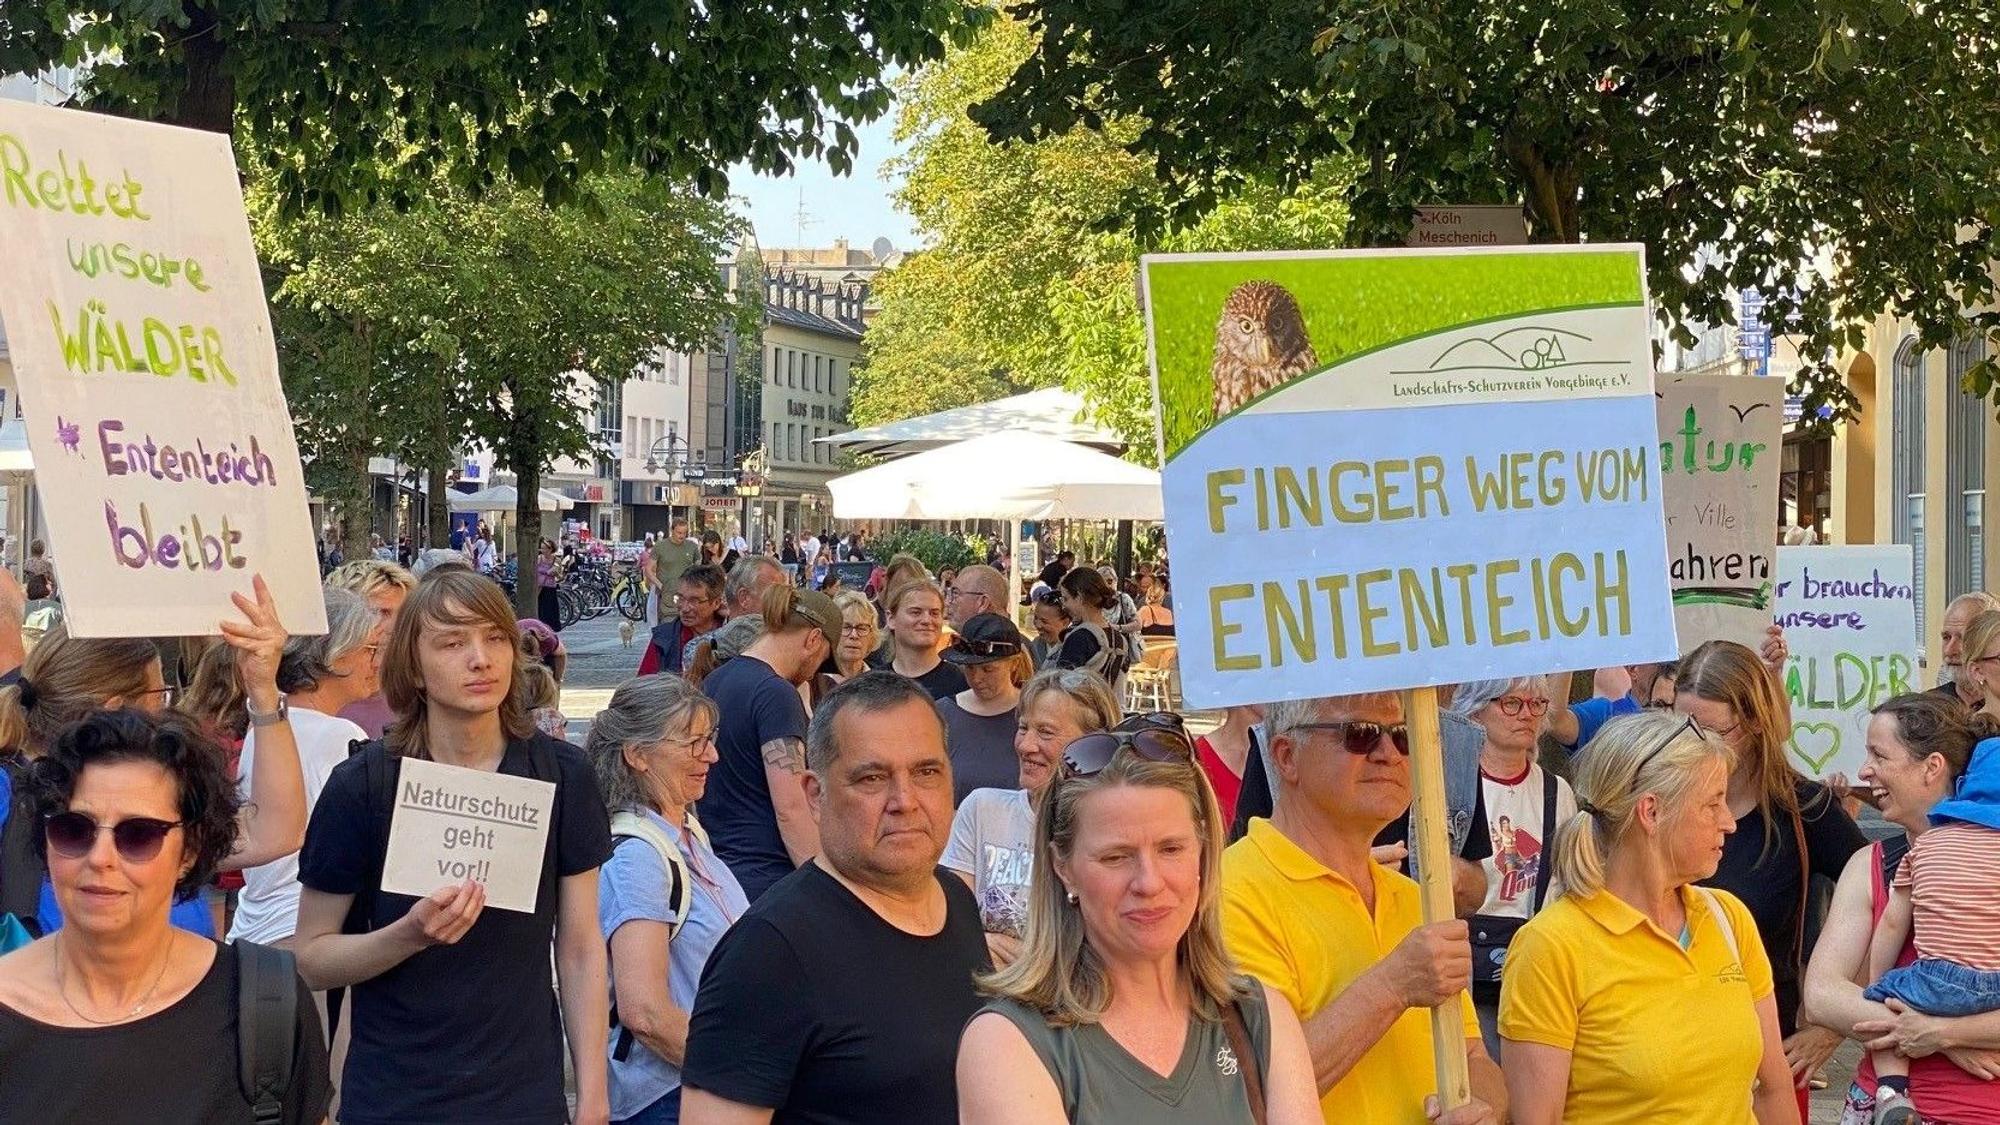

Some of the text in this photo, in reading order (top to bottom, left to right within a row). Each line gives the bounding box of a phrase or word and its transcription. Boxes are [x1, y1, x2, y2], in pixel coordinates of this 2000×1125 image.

[0, 133, 151, 221] Rettet
[1419, 230, 1497, 243] Meschenich
[1432, 211, 1462, 225] Köln
[67, 237, 213, 292] unsere
[46, 298, 239, 387] WÄLDER
[98, 420, 277, 487] Ententeich
[1206, 446, 1648, 533] FINGER WEG VOM
[104, 500, 248, 571] bleibt
[1694, 502, 1736, 529] Ville
[1803, 566, 1912, 600] brauchen
[1209, 549, 1632, 671] ENTENTEICH
[1773, 610, 1868, 631] unsere
[402, 781, 540, 825] Naturschutz
[443, 826, 496, 850] geht
[437, 859, 490, 883] vor!!
